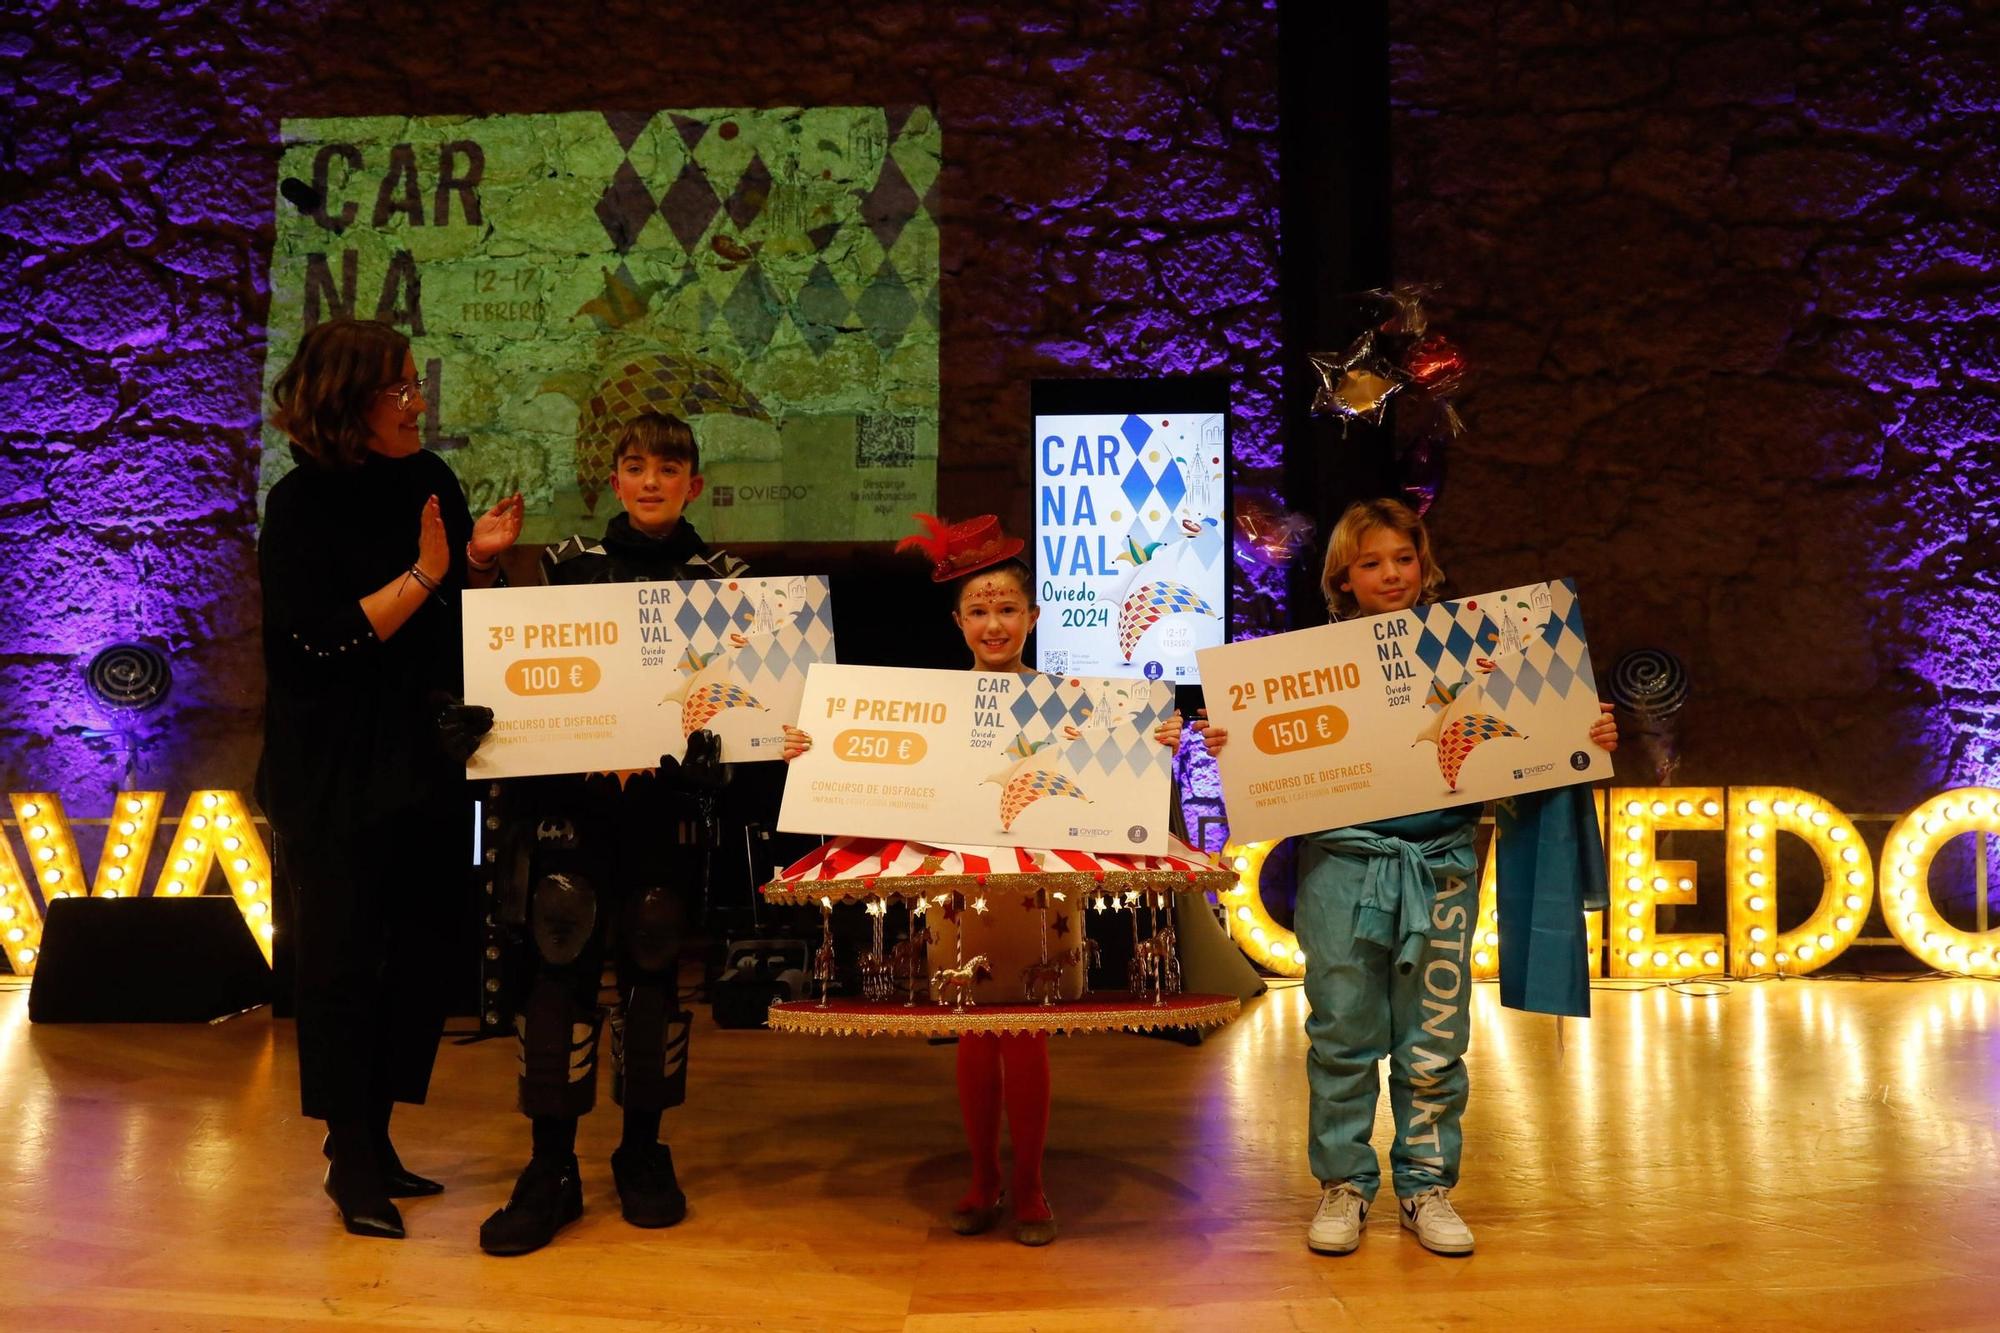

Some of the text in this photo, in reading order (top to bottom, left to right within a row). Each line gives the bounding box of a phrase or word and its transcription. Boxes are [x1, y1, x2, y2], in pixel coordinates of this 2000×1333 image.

[311, 140, 485, 233] CAR
[474, 268, 537, 293] 12-17
[302, 248, 427, 337] NA
[462, 301, 546, 322] FEBRERO
[1042, 435, 1120, 476] CAR
[739, 485, 808, 500] OVIEDO
[1042, 485, 1097, 526] NA
[1042, 535, 1119, 576] VAL
[638, 588, 671, 605] CAR
[1042, 580, 1096, 602] Oviedo
[639, 607, 662, 624] NA
[1061, 608, 1108, 628] 2024
[488, 621, 619, 651] 3º PREMIO
[640, 626, 672, 643] VAL
[1373, 618, 1408, 641] CAR
[641, 645, 666, 656] Oviedo
[1376, 641, 1403, 661] NA
[642, 656, 663, 666] 2024
[1381, 660, 1416, 681] VAL
[520, 664, 584, 691] 100 €
[977, 677, 1010, 693] CAR
[1229, 662, 1360, 711] 2º PREMIO
[1385, 682, 1411, 695] Oviedo
[826, 697, 947, 724] 1º PREMIO
[975, 694, 997, 710] NA
[1388, 694, 1411, 707] 2024
[493, 714, 617, 732] CONCURSO DE DISFRACES
[974, 711, 1005, 728] VAL
[971, 728, 996, 738] Oviedo
[1268, 714, 1332, 748] 150 €
[846, 735, 912, 760] 250 €
[970, 739, 992, 748] 2024
[1248, 762, 1373, 796] CONCURSO DE DISFRACES
[1524, 763, 1553, 775] OVIEDO
[811, 780, 936, 799] CONCURSO DE DISFRACES
[1331, 780, 1372, 794] INDIVIDUAL
[1080, 828, 1110, 837] OVIEDO
[1421, 874, 1468, 1040] ASTON
